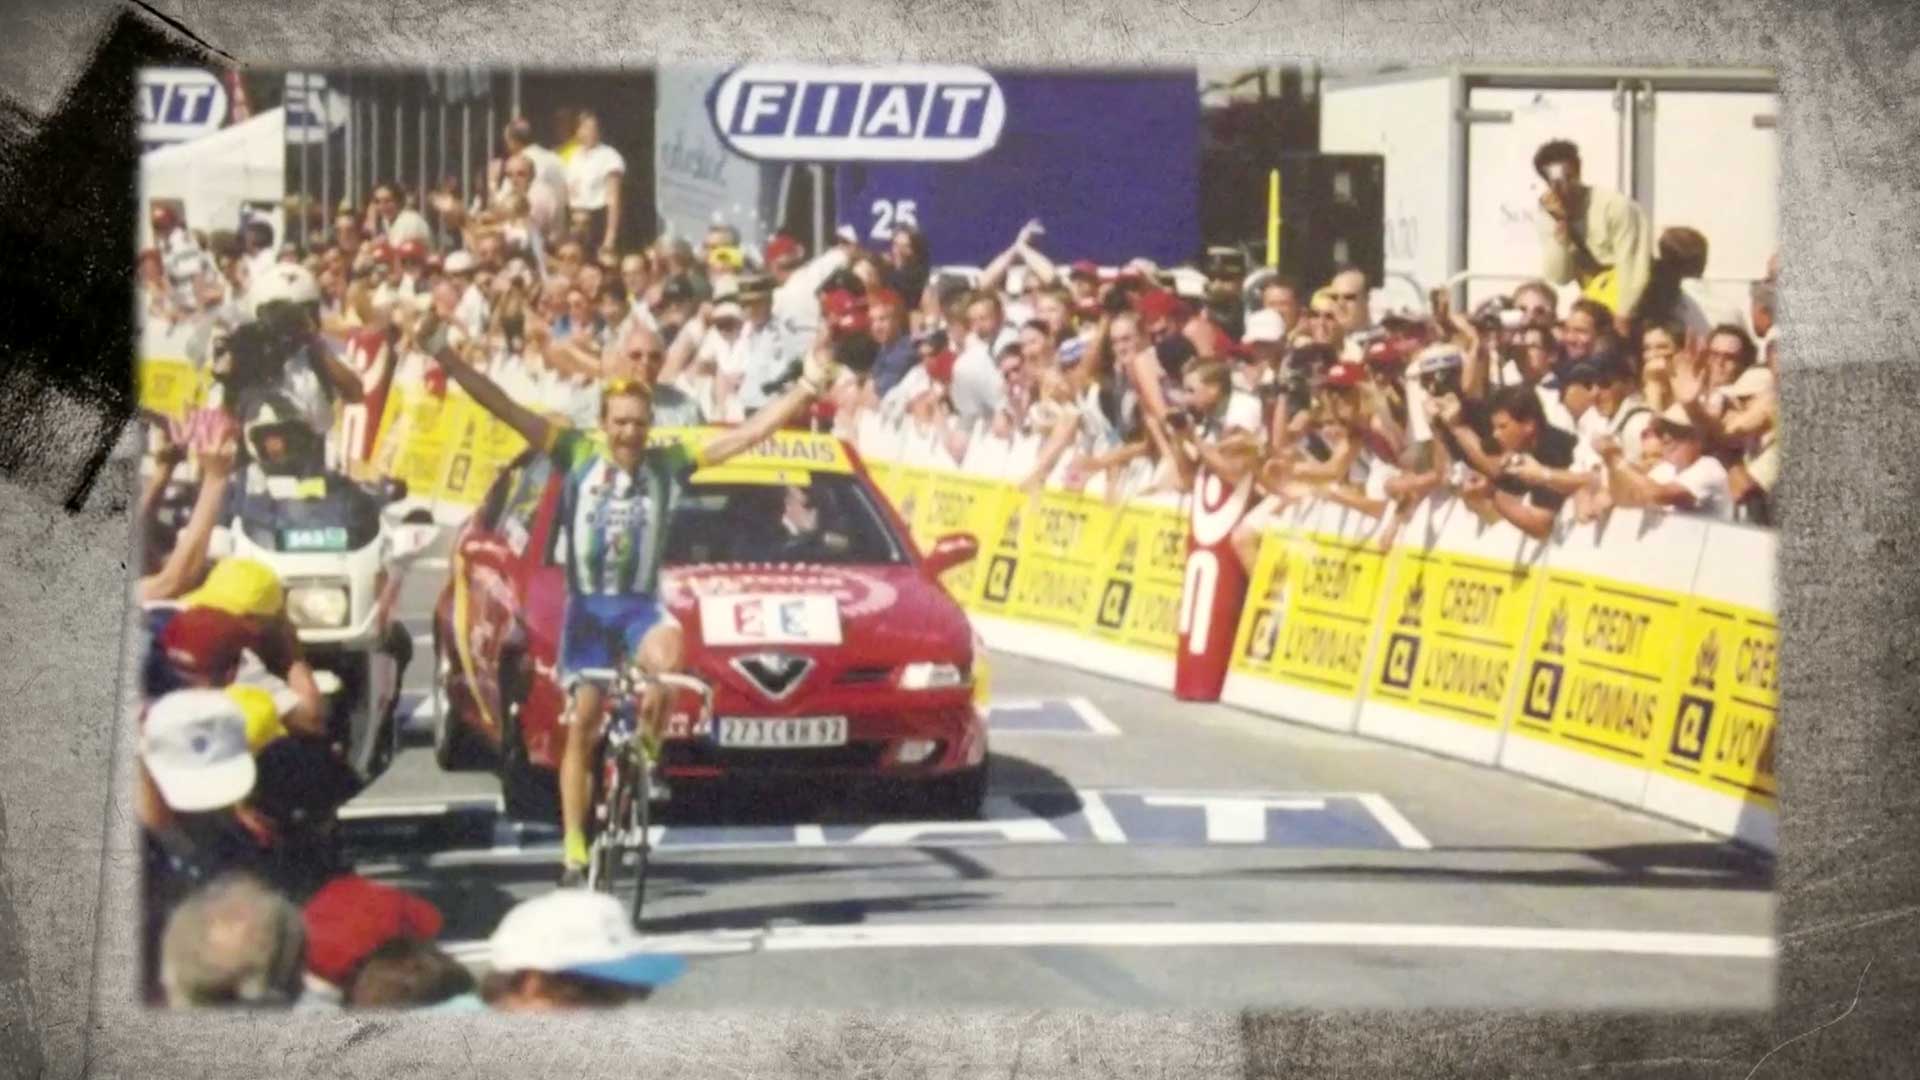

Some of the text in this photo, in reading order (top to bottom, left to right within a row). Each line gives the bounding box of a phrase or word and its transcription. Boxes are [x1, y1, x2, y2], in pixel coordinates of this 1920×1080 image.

[740, 84, 984, 136] FIAT
[870, 199, 918, 239] 25
[754, 435, 838, 464] NNAIS
[1439, 577, 1505, 627] CREDIT
[1581, 602, 1652, 660] CREDIT
[1422, 647, 1511, 702] LYONNAIS
[1735, 634, 1778, 691] CRE
[1562, 675, 1658, 740] LYONNAIS
